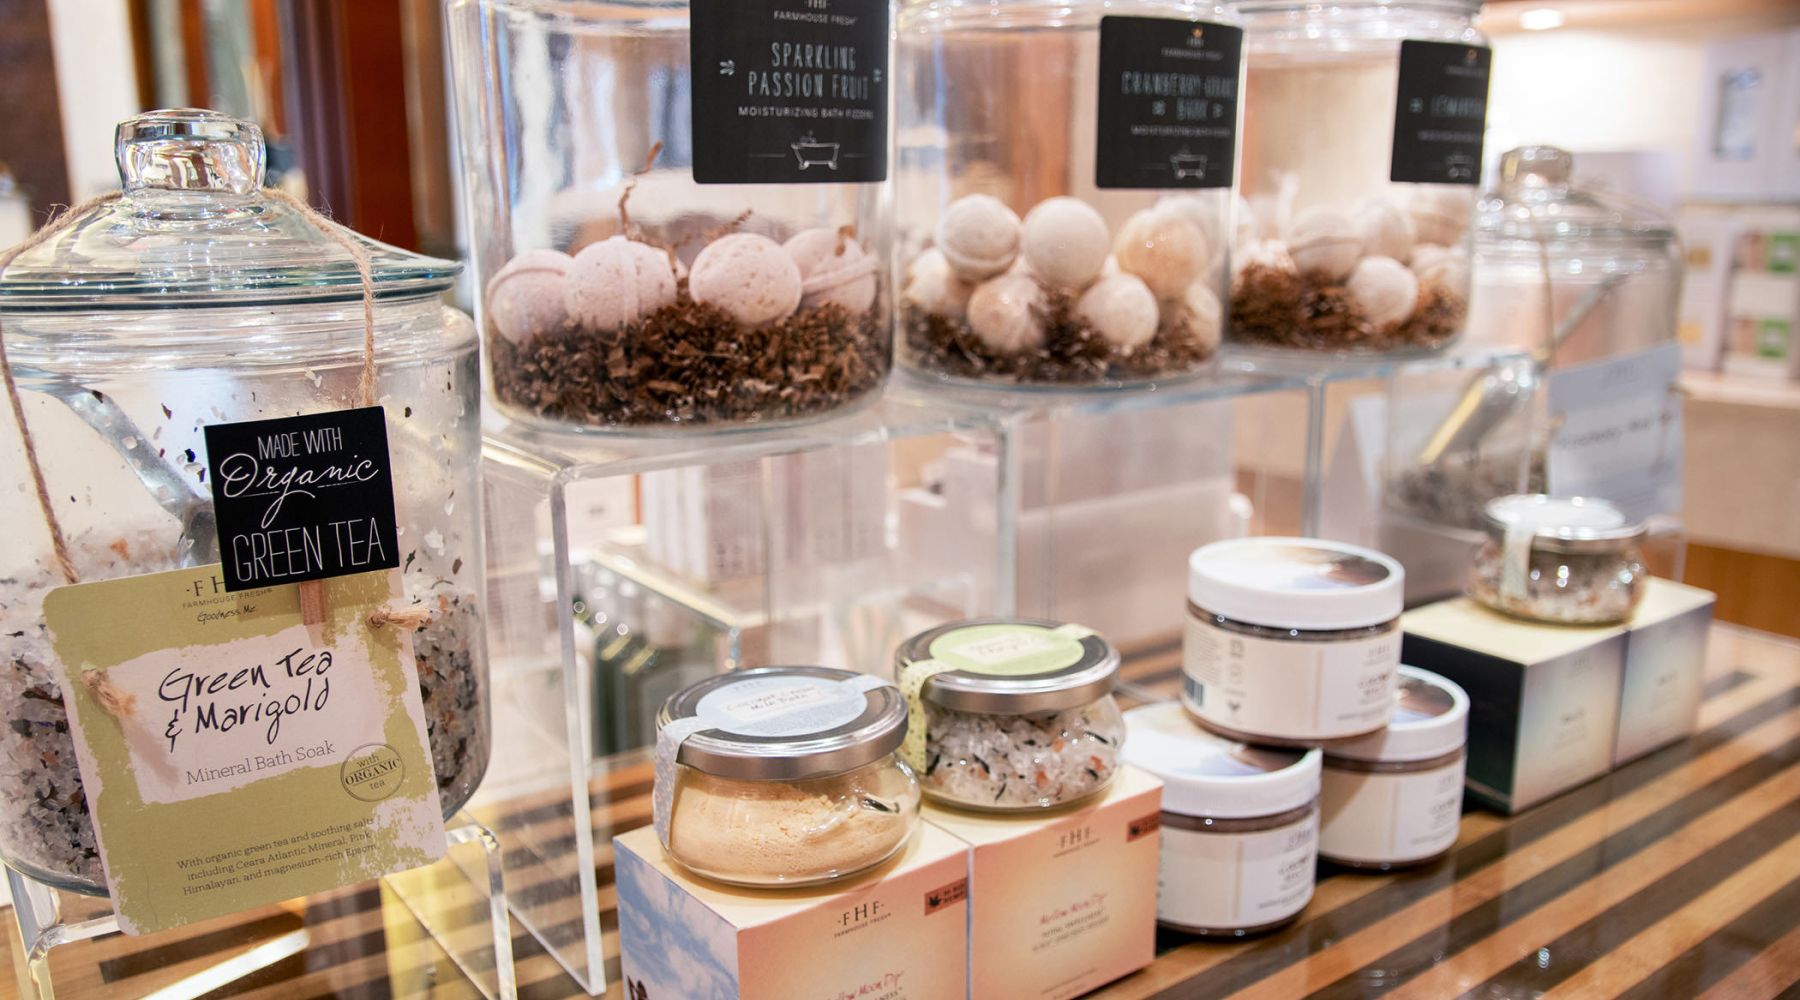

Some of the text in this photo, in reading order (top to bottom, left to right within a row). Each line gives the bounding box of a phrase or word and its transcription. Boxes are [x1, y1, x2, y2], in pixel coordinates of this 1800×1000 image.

[771, 41, 857, 72] SPARKLING
[748, 70, 869, 100] PASSION FRUIT
[738, 105, 819, 119] MOISTURIZING
[257, 426, 343, 461] MADE WITH
[220, 452, 379, 529] Organic
[232, 517, 386, 582] GREEN TEA
[182, 594, 236, 609] FARMHOUSE
[158, 647, 333, 714] Green Tea
[164, 677, 330, 753] & Marigold
[186, 740, 335, 785] Mineral Bath Soak
[344, 757, 401, 786] ORGANIC
[355, 753, 380, 769] with
[368, 778, 386, 791] tea
[176, 856, 205, 870] With
[205, 850, 243, 866] organic
[243, 842, 273, 858] green
[273, 838, 289, 848] tea
[290, 831, 310, 844] and
[310, 822, 352, 840] soothing
[186, 862, 236, 881] including
[235, 856, 266, 869] Ceara
[267, 847, 307, 864] Atlantic
[349, 830, 372, 843] Pink
[243, 869, 263, 882] and
[263, 850, 345, 878] magnesium-rich
[842, 900, 880, 926] FHF
